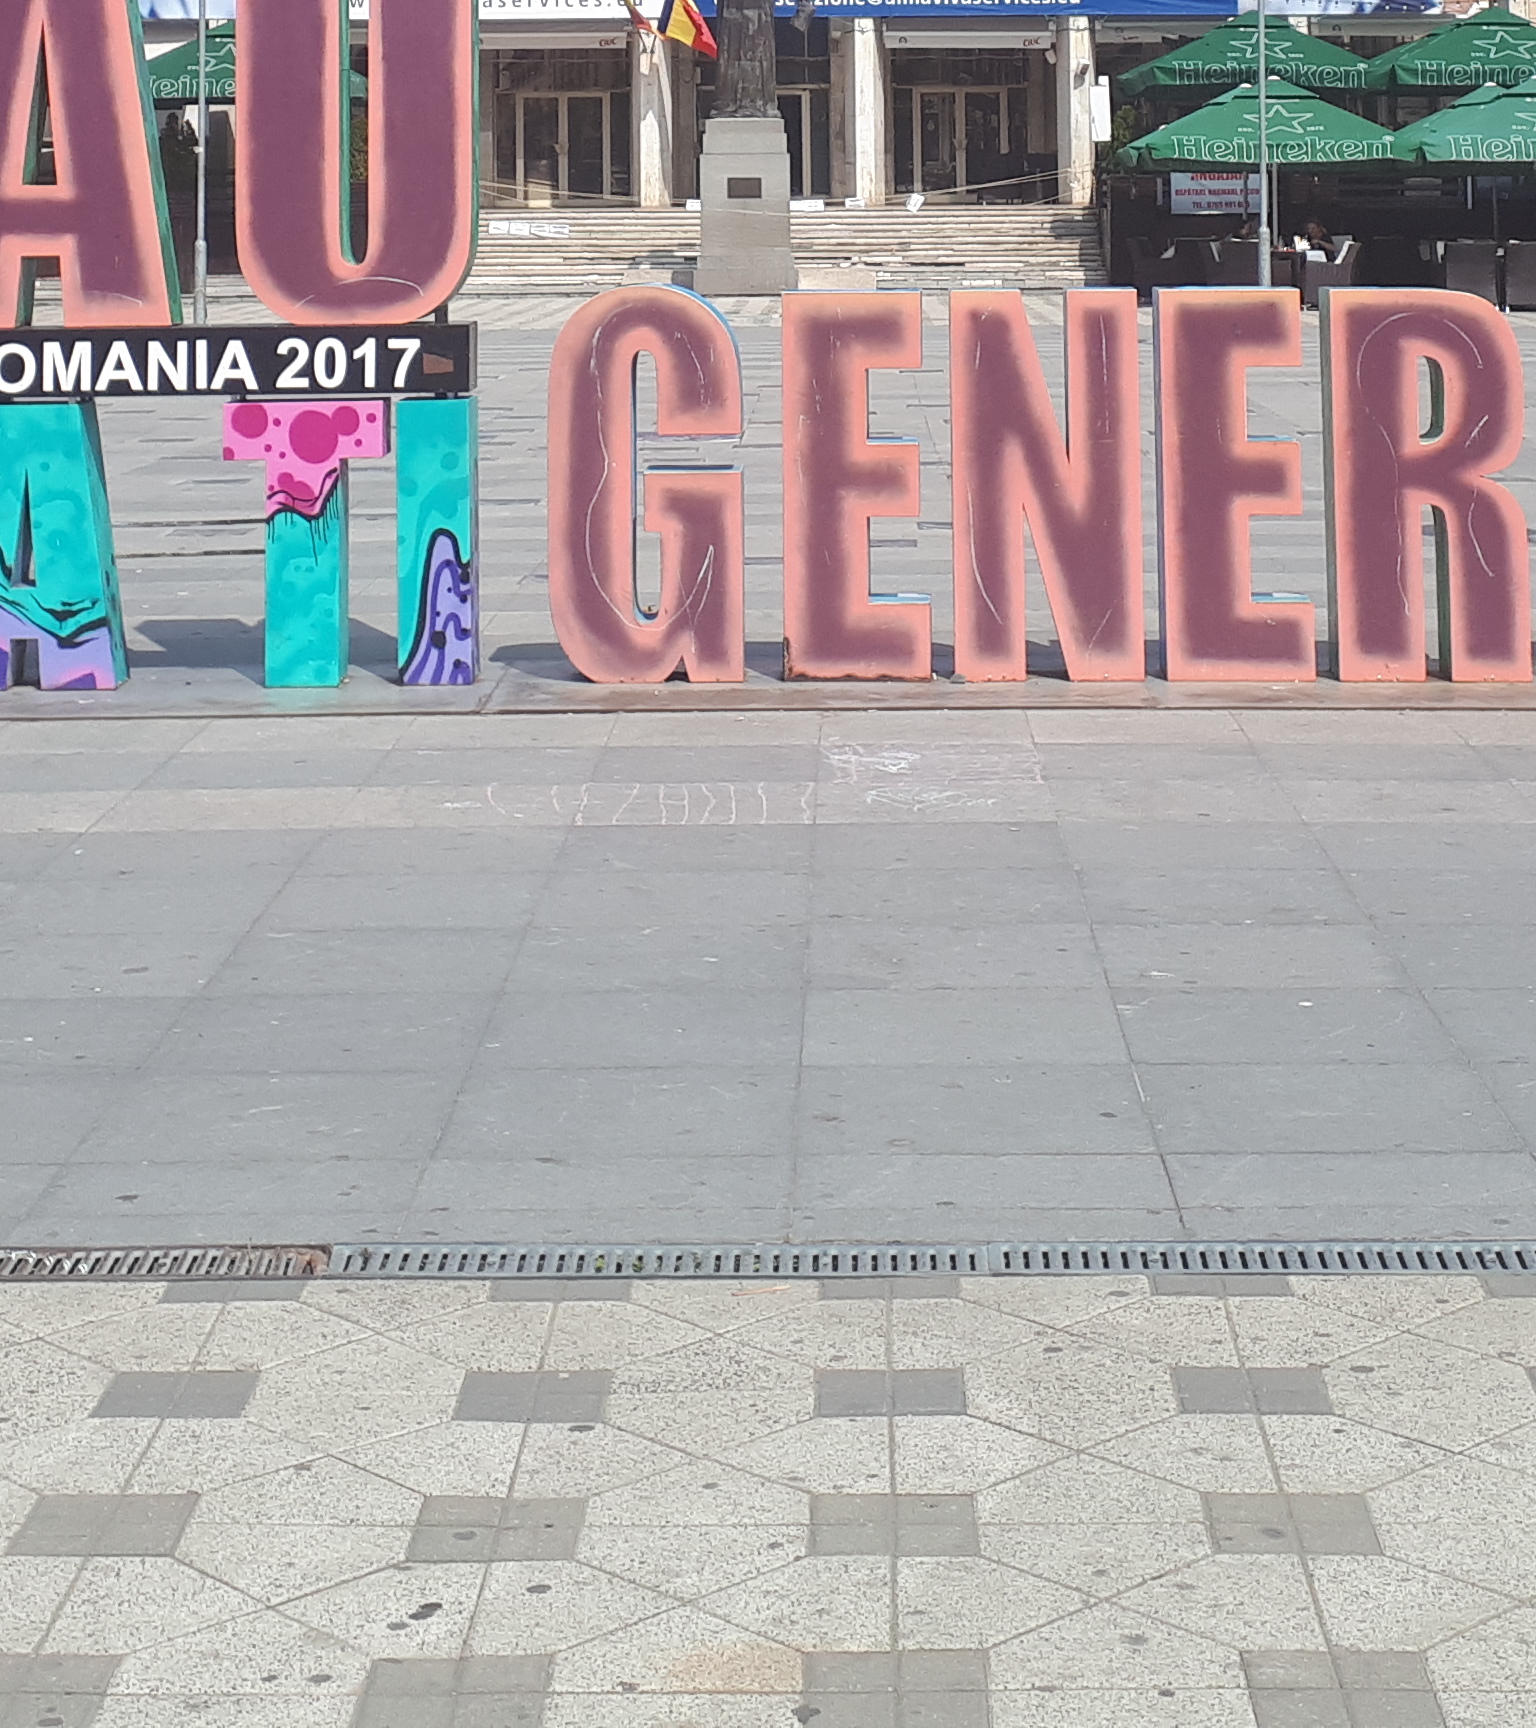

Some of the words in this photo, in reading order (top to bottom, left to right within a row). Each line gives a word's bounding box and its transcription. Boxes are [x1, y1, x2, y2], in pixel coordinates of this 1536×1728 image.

[1172, 60, 1368, 89] Heineken
[1171, 134, 1395, 164] Heineken
[275, 338, 422, 390] 2017
